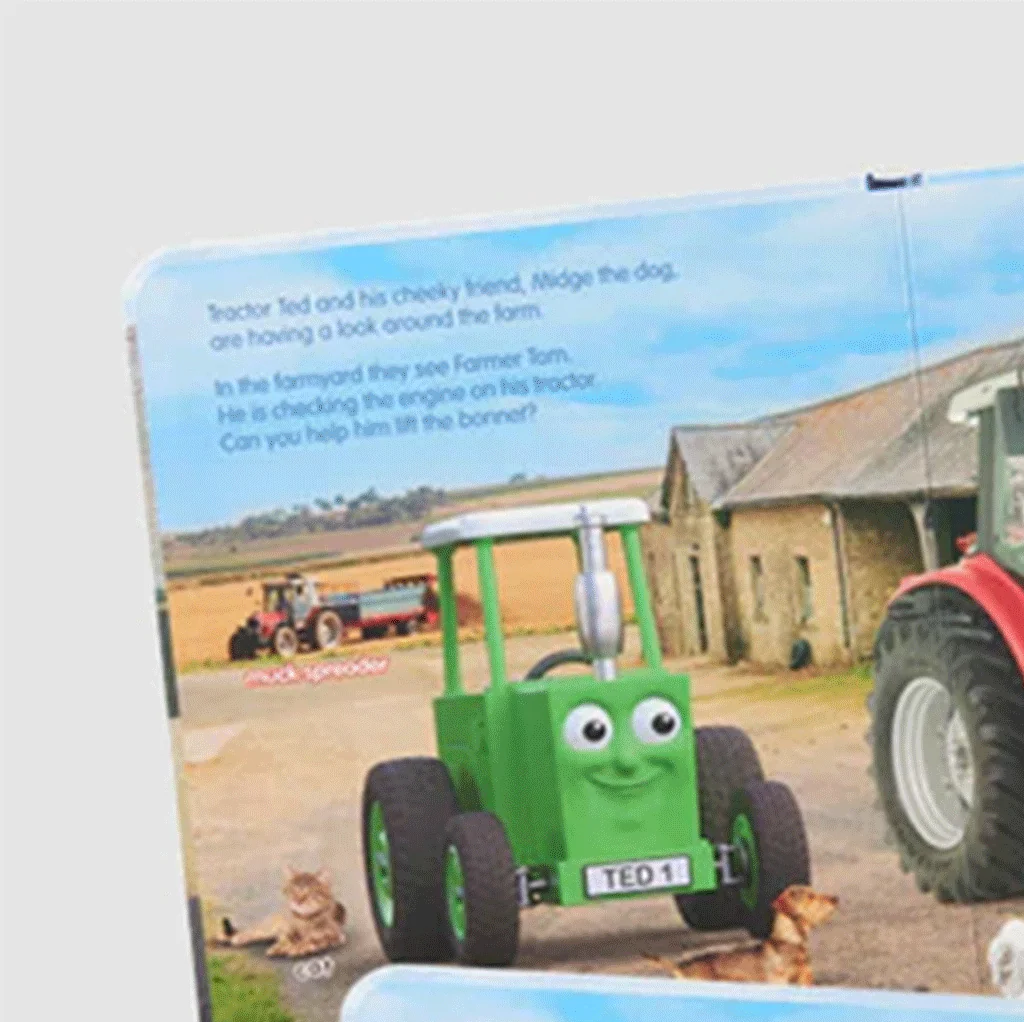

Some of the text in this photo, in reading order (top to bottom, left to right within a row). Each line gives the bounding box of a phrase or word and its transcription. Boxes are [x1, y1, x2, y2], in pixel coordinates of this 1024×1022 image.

[208, 303, 271, 322] Tractor
[278, 295, 311, 314] Ted
[316, 291, 354, 311] and
[360, 291, 387, 308] his
[392, 282, 459, 302] cheeky
[466, 275, 526, 296] friend,
[532, 270, 593, 292] Midge
[597, 266, 629, 283] the
[210, 334, 243, 351] are
[248, 327, 314, 346] having
[319, 325, 332, 341] a
[337, 317, 376, 337] look
[382, 308, 454, 335] around
[459, 307, 489, 324] the
[215, 380, 233, 396] In
[238, 376, 269, 393] the
[274, 365, 363, 390] farmyard
[368, 362, 409, 382] they
[415, 359, 448, 377] see
[454, 353, 522, 373] Farmer
[218, 405, 245, 424] He
[252, 405, 266, 421] is
[272, 395, 357, 416] checking
[363, 392, 393, 409] the
[399, 387, 466, 408] engine
[470, 380, 496, 401] on
[500, 377, 529, 396] his
[219, 402, 538, 453] Can you help him lift the bonnet?
[602, 863, 672, 889] TED 1
[292, 956, 335, 982] cat
